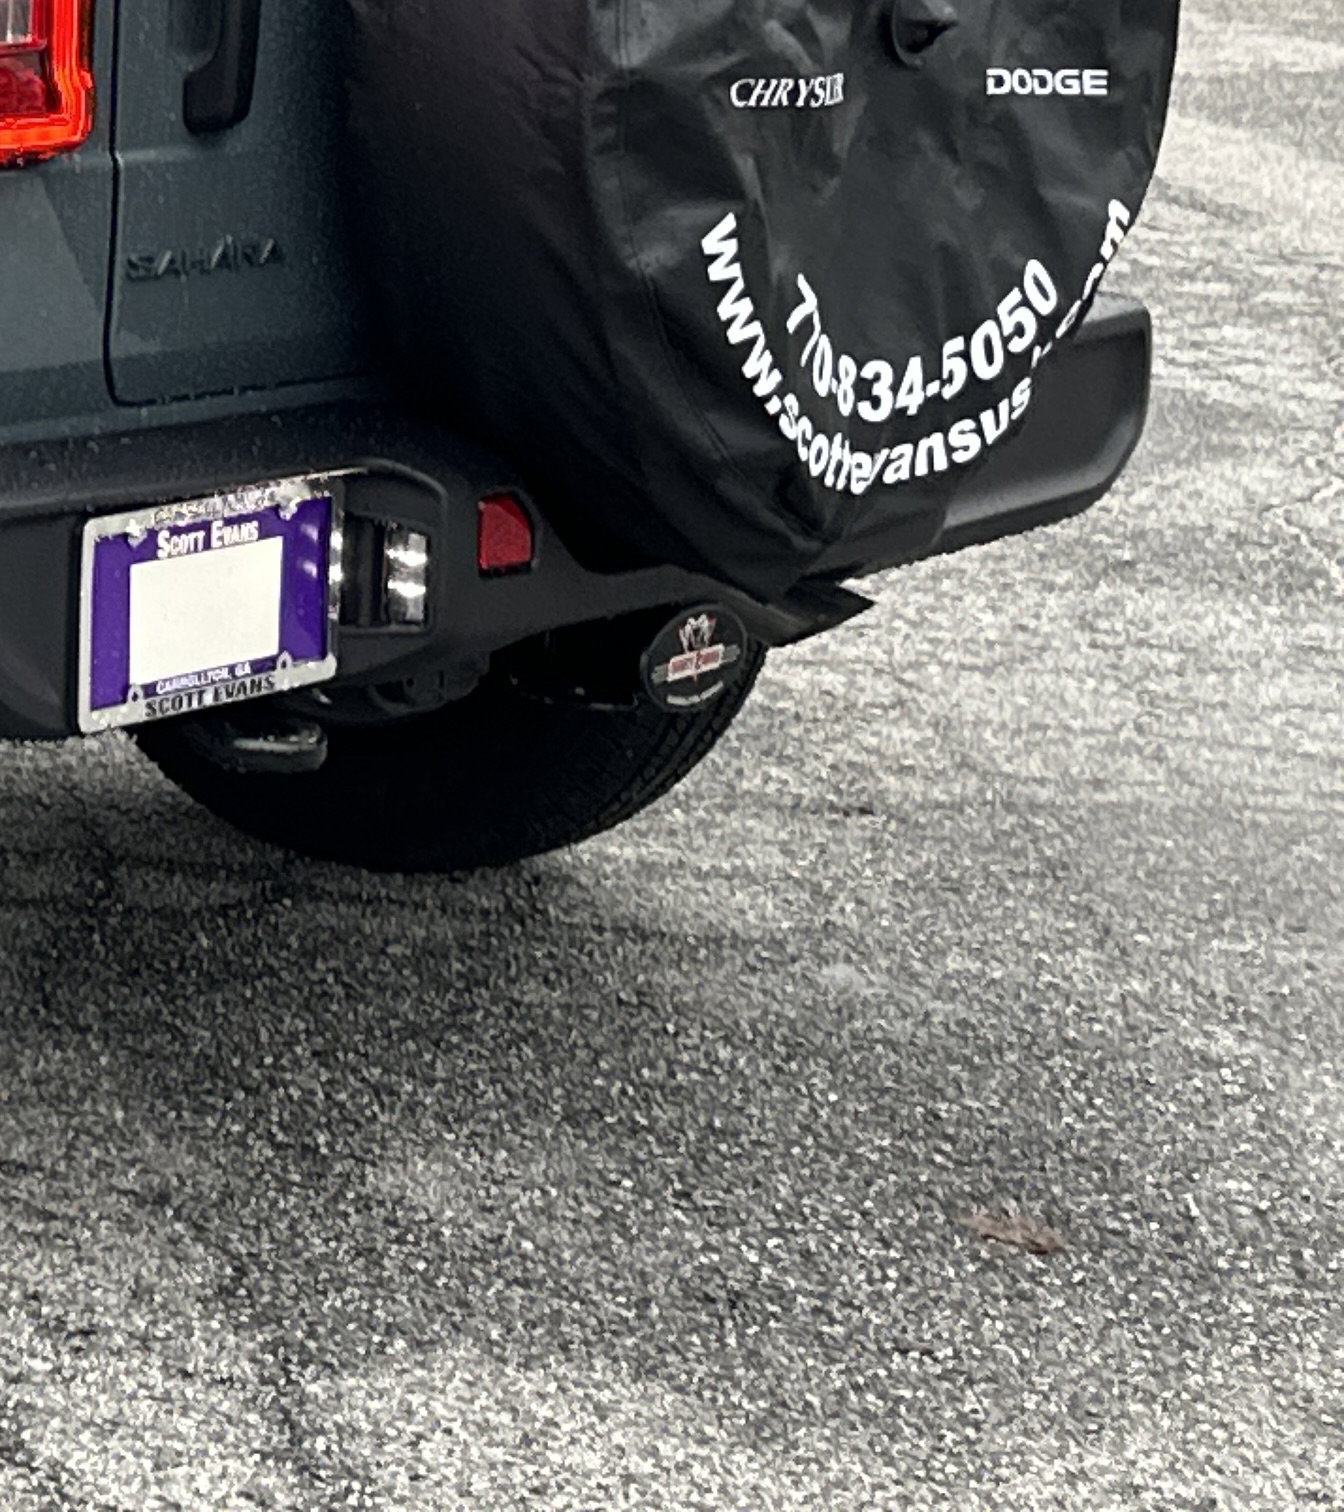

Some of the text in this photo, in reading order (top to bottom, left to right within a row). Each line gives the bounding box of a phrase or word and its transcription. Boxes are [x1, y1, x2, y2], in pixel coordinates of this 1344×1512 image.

[986, 68, 1109, 96] DODGE
[126, 234, 286, 282] SAHARA
[157, 520, 259, 559] SCOTT EVANS
[145, 675, 275, 718] SCOTT EVANS
